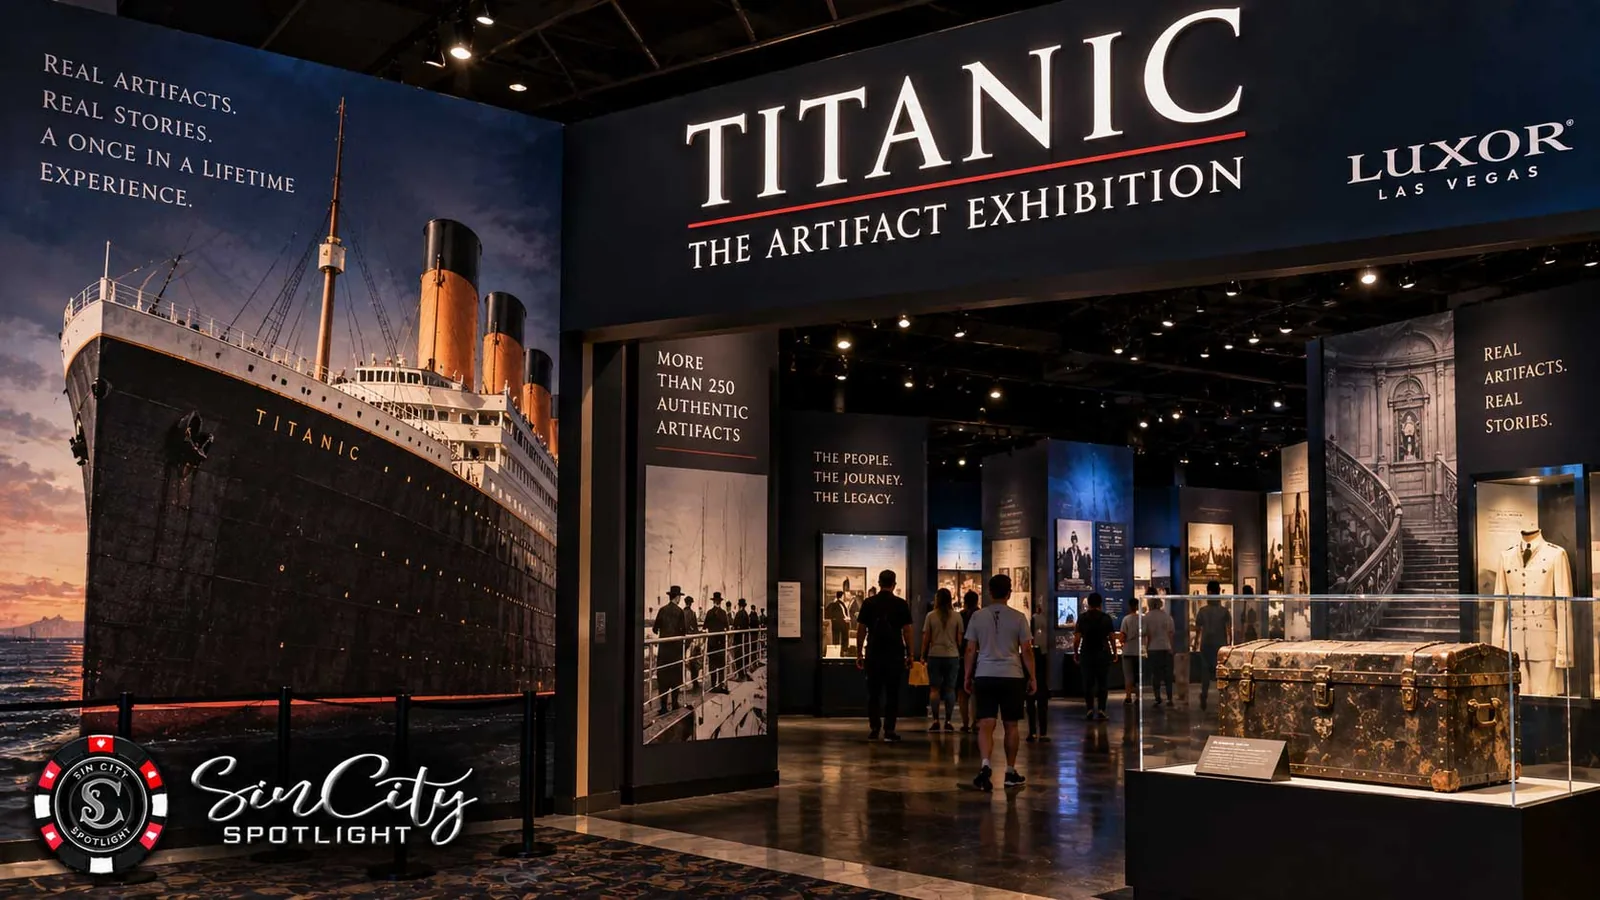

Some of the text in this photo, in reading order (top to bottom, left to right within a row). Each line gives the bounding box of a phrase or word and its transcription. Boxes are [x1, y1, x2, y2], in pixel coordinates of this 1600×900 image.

[44, 53, 237, 116] REAL ARTIFACTS.
[43, 89, 213, 143] REAL STORIES.
[686, 7, 1244, 209] TITANIC
[39, 127, 295, 194] A ONCE IN A LIFETIME
[40, 161, 194, 208] EXPERIENCE.
[1378, 163, 1538, 201] LAS VEGAS
[688, 156, 1244, 270] THE ARTIFACT EXHIBITION
[657, 350, 704, 371] MORE
[1484, 342, 1522, 362] REAL
[656, 372, 735, 395] THAN 250
[1484, 359, 1568, 385] ARTIFACTS.
[656, 396, 749, 420] AUTHENTIC
[1485, 391, 1523, 410] REAL
[256, 409, 360, 460] TITANIC
[656, 420, 741, 442] ARTIFACTS
[1485, 413, 1553, 434] STORIES.
[813, 451, 893, 466] THE PEOPLE.
[813, 471, 903, 486] THE JOURNEY.
[813, 491, 894, 505] THE LEGACY.
